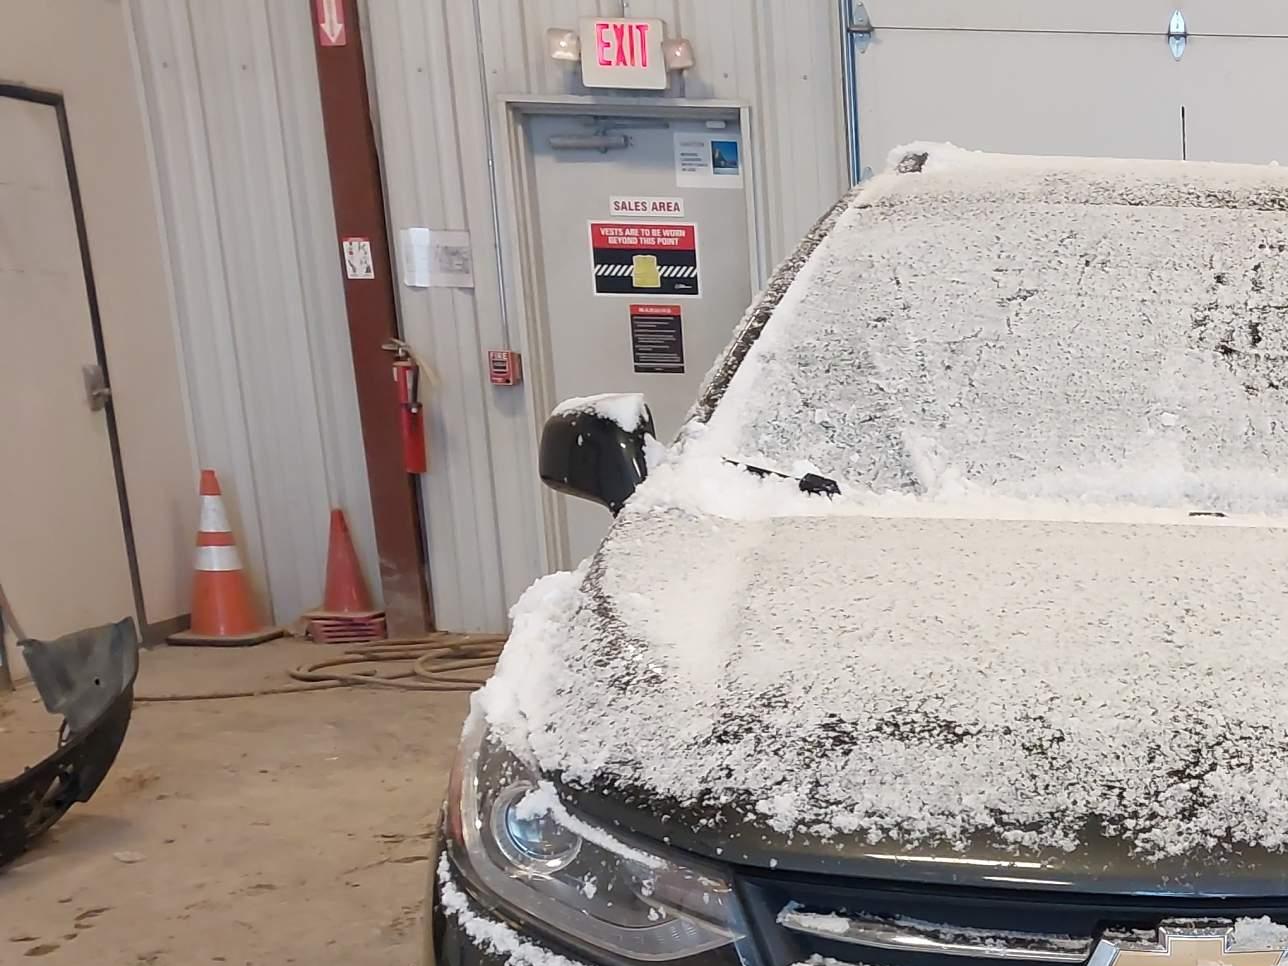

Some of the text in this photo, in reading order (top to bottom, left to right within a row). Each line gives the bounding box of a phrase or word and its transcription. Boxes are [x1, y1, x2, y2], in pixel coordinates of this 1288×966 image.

[595, 23, 649, 67] EXIT
[614, 201, 680, 212] SALES AREA
[600, 227, 686, 238] VESTS ARE TO BE WORN
[608, 236, 679, 246] BEYOND THIS POINT
